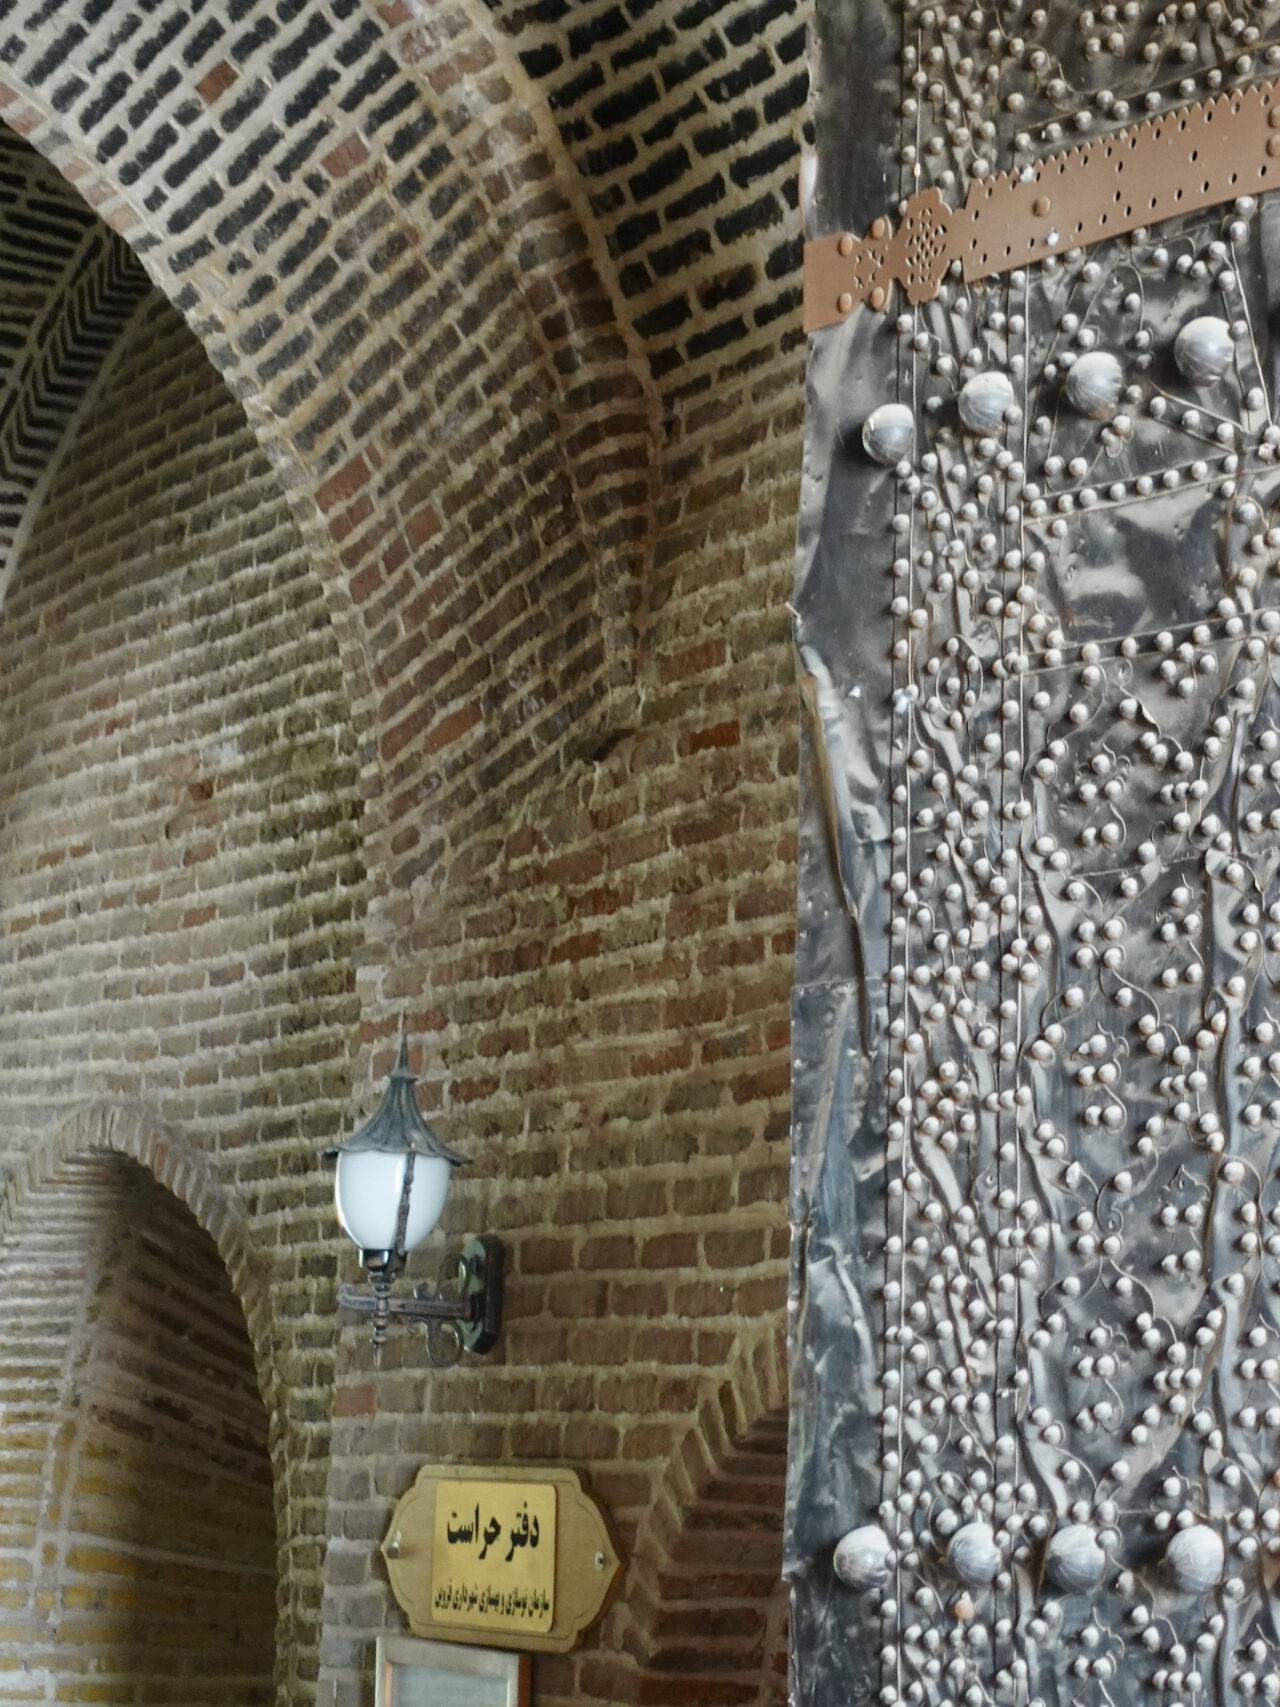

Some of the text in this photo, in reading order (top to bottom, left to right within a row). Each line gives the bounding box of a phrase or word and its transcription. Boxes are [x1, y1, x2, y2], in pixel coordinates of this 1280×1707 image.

[447, 1501, 539, 1561] دفتر حراست
[435, 1578, 452, 1610] قزوین
[452, 1582, 478, 1612] شهرداری
[479, 1584, 500, 1613] بهسازی
[506, 1586, 527, 1617] نوسازی
[528, 1587, 550, 1618] سازمان
